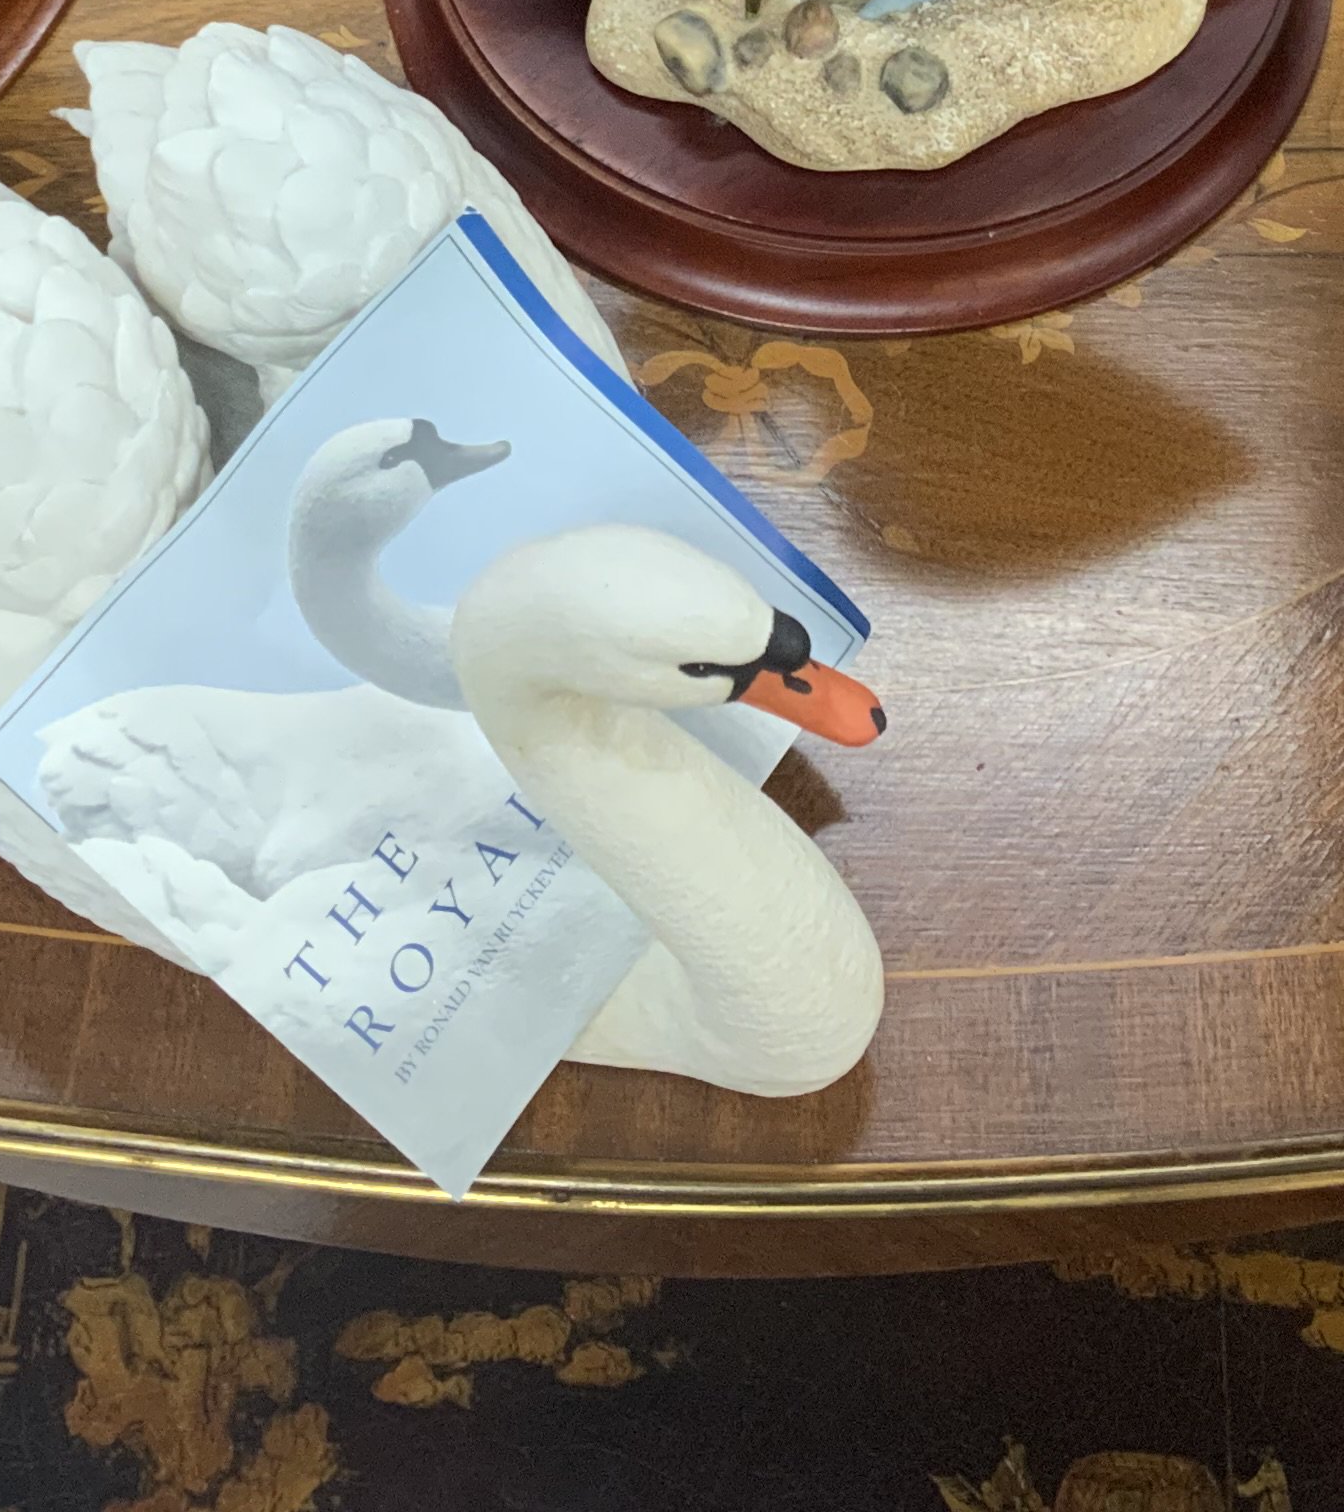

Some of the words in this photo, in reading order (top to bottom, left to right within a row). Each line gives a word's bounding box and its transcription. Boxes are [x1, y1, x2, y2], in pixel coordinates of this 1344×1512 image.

[283, 831, 420, 992] THE
[394, 1053, 419, 1085] BY
[413, 978, 472, 1056] RONALD
[467, 940, 499, 979] VAN
[493, 839, 576, 944] RUYCKEVEL
